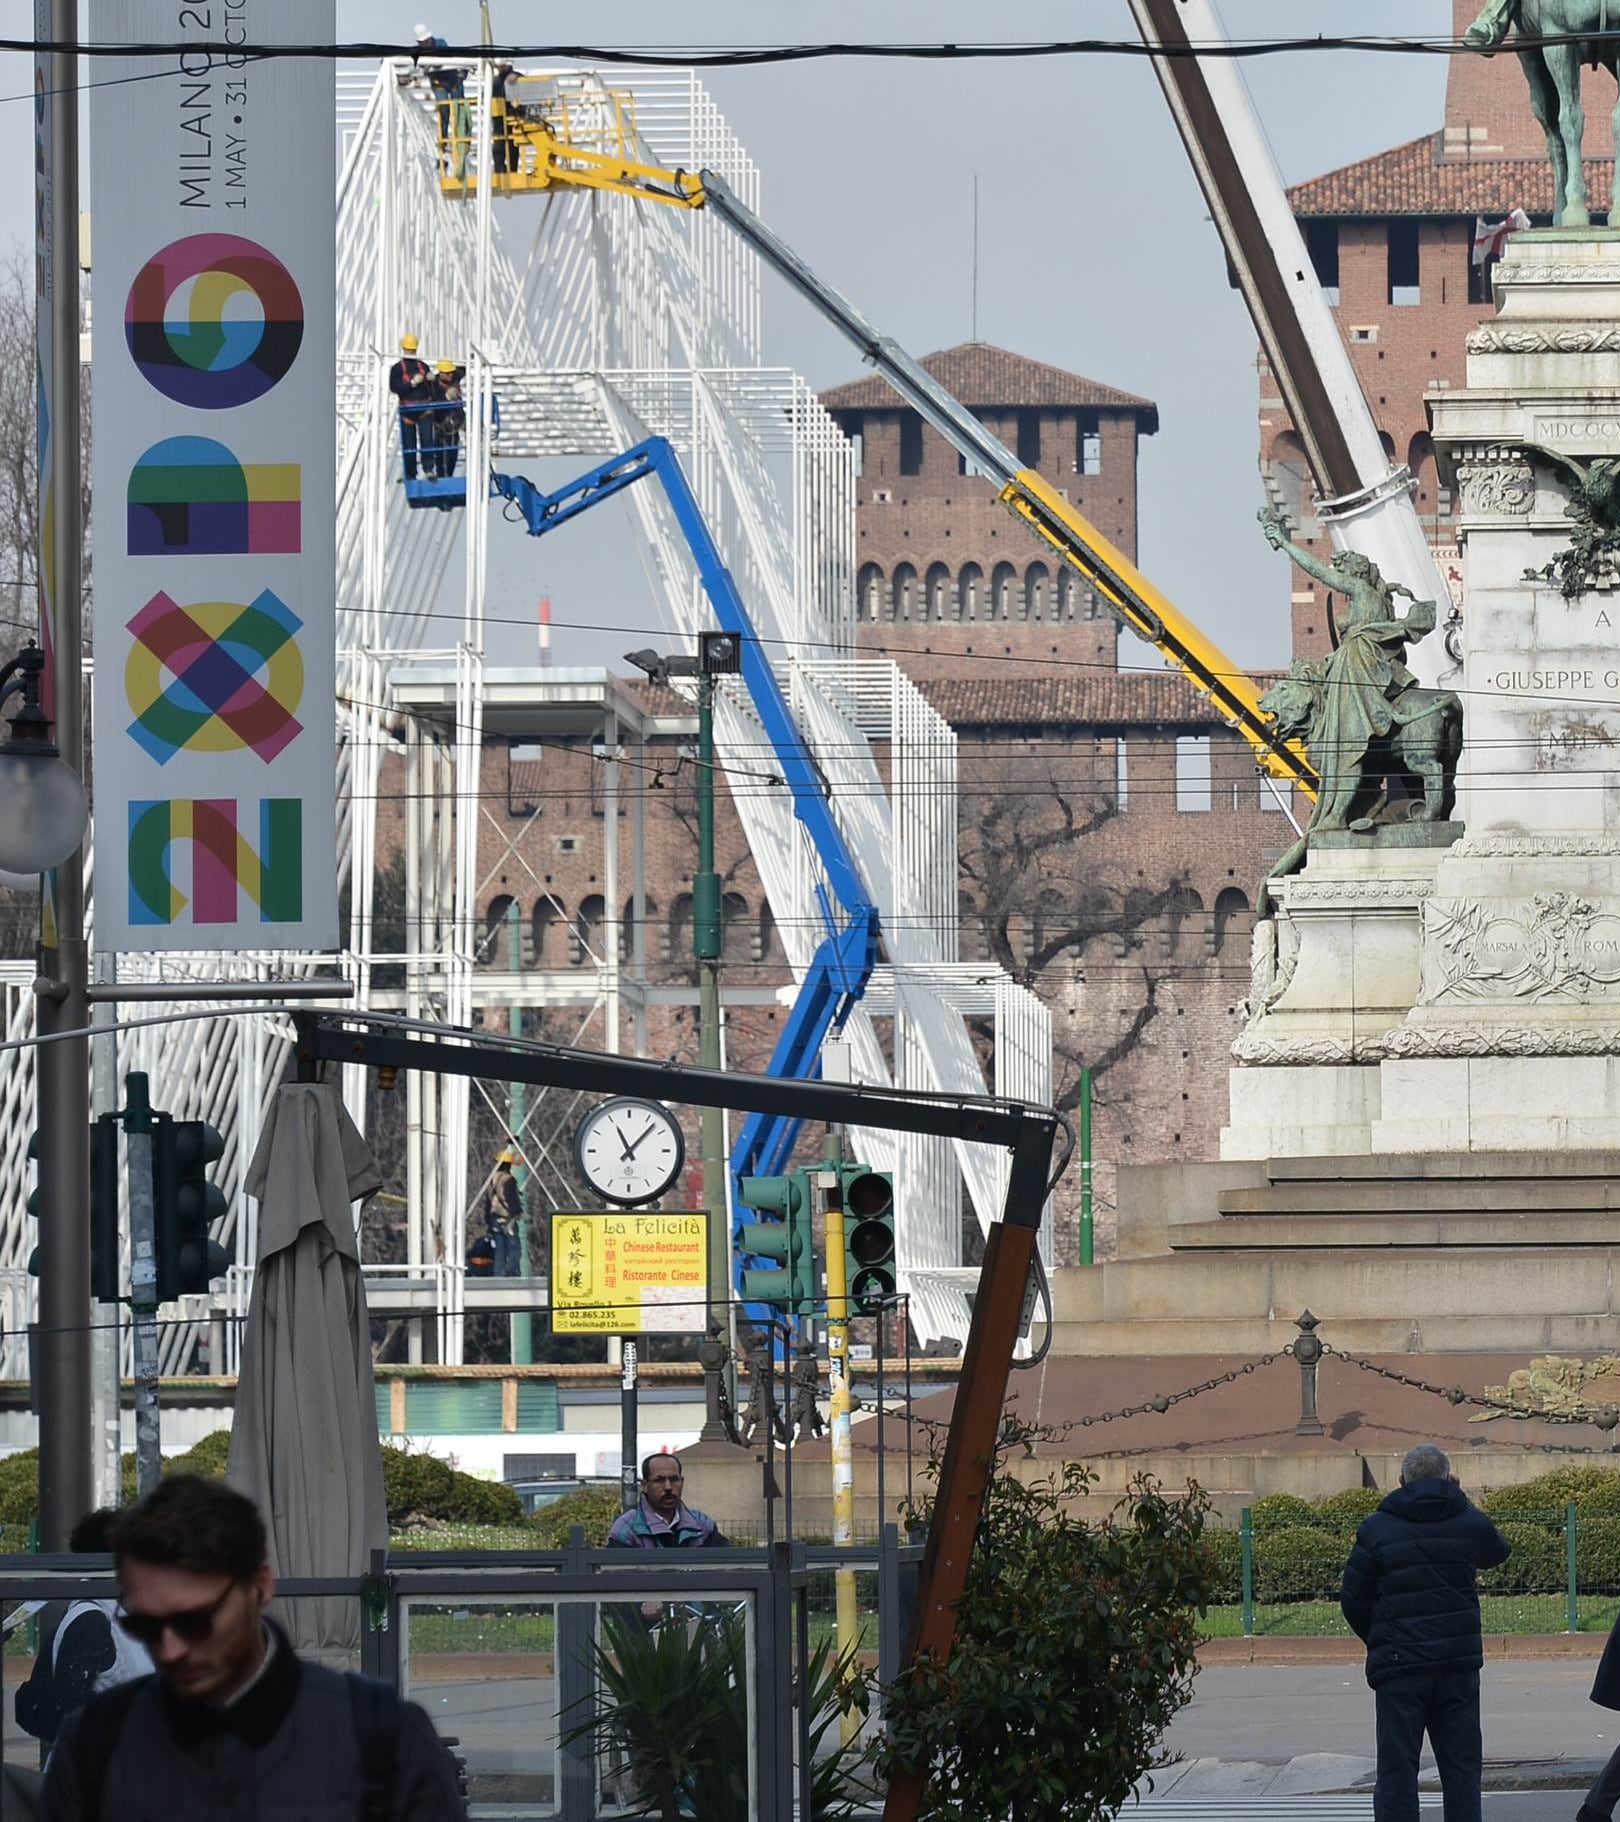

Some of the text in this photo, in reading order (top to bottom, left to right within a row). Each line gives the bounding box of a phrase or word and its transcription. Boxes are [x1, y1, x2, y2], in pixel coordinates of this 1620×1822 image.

[225, 78, 247, 105] 31
[179, 45, 212, 208] MILANO
[225, 133, 247, 188] MAY
[225, 197, 247, 209] 1
[1594, 610, 1612, 628] A
[1495, 670, 1594, 690] GIUSEPPE
[1479, 942, 1527, 952] MARSALA
[603, 1217, 701, 1235] La Felicità
[623, 1241, 700, 1253] Chinese Restaurant
[622, 1269, 700, 1281] Ristorante Cinese
